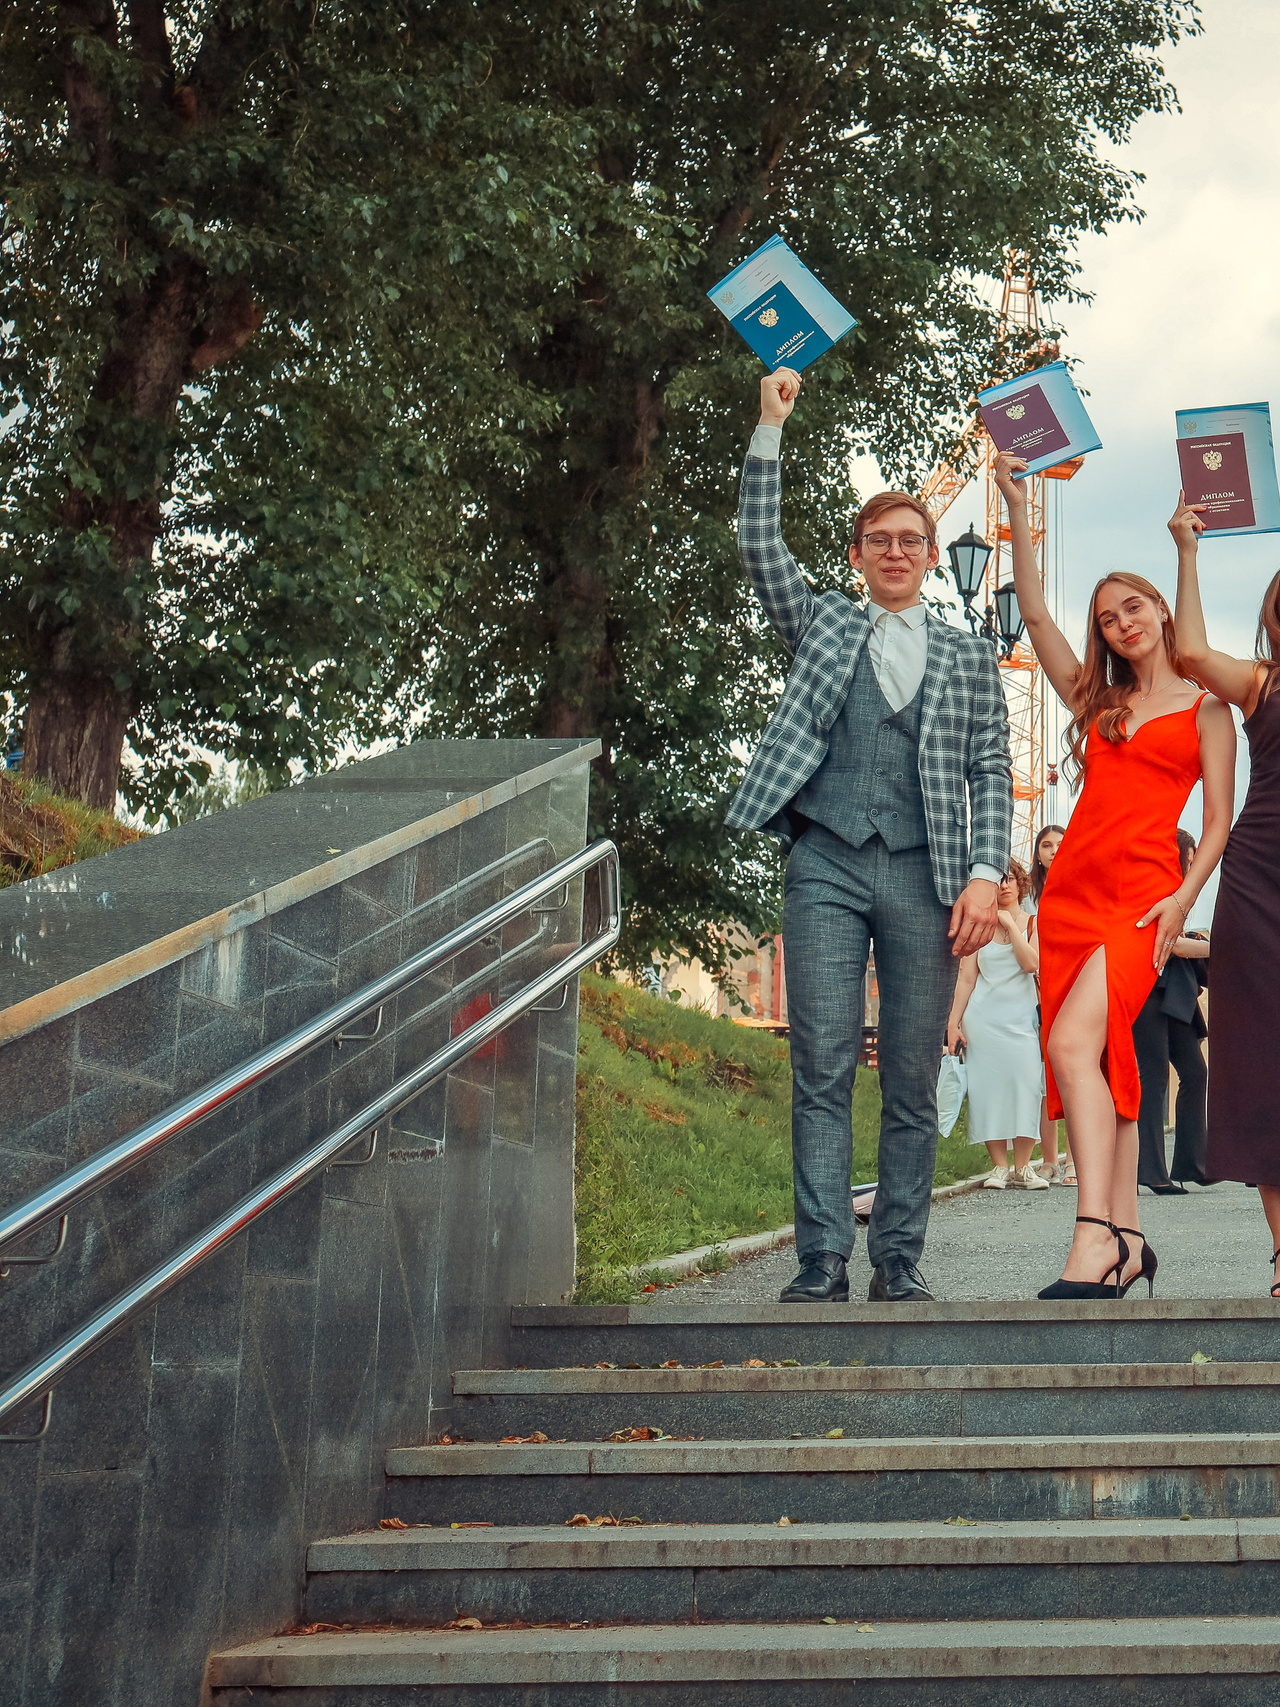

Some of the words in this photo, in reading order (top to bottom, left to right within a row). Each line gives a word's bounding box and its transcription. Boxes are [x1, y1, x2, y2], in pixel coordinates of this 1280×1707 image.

[776, 330, 804, 356] ДИПЛОМ
[1011, 427, 1045, 444] ДИПЛОМ
[1200, 491, 1235, 501] ДИПЛОМ
